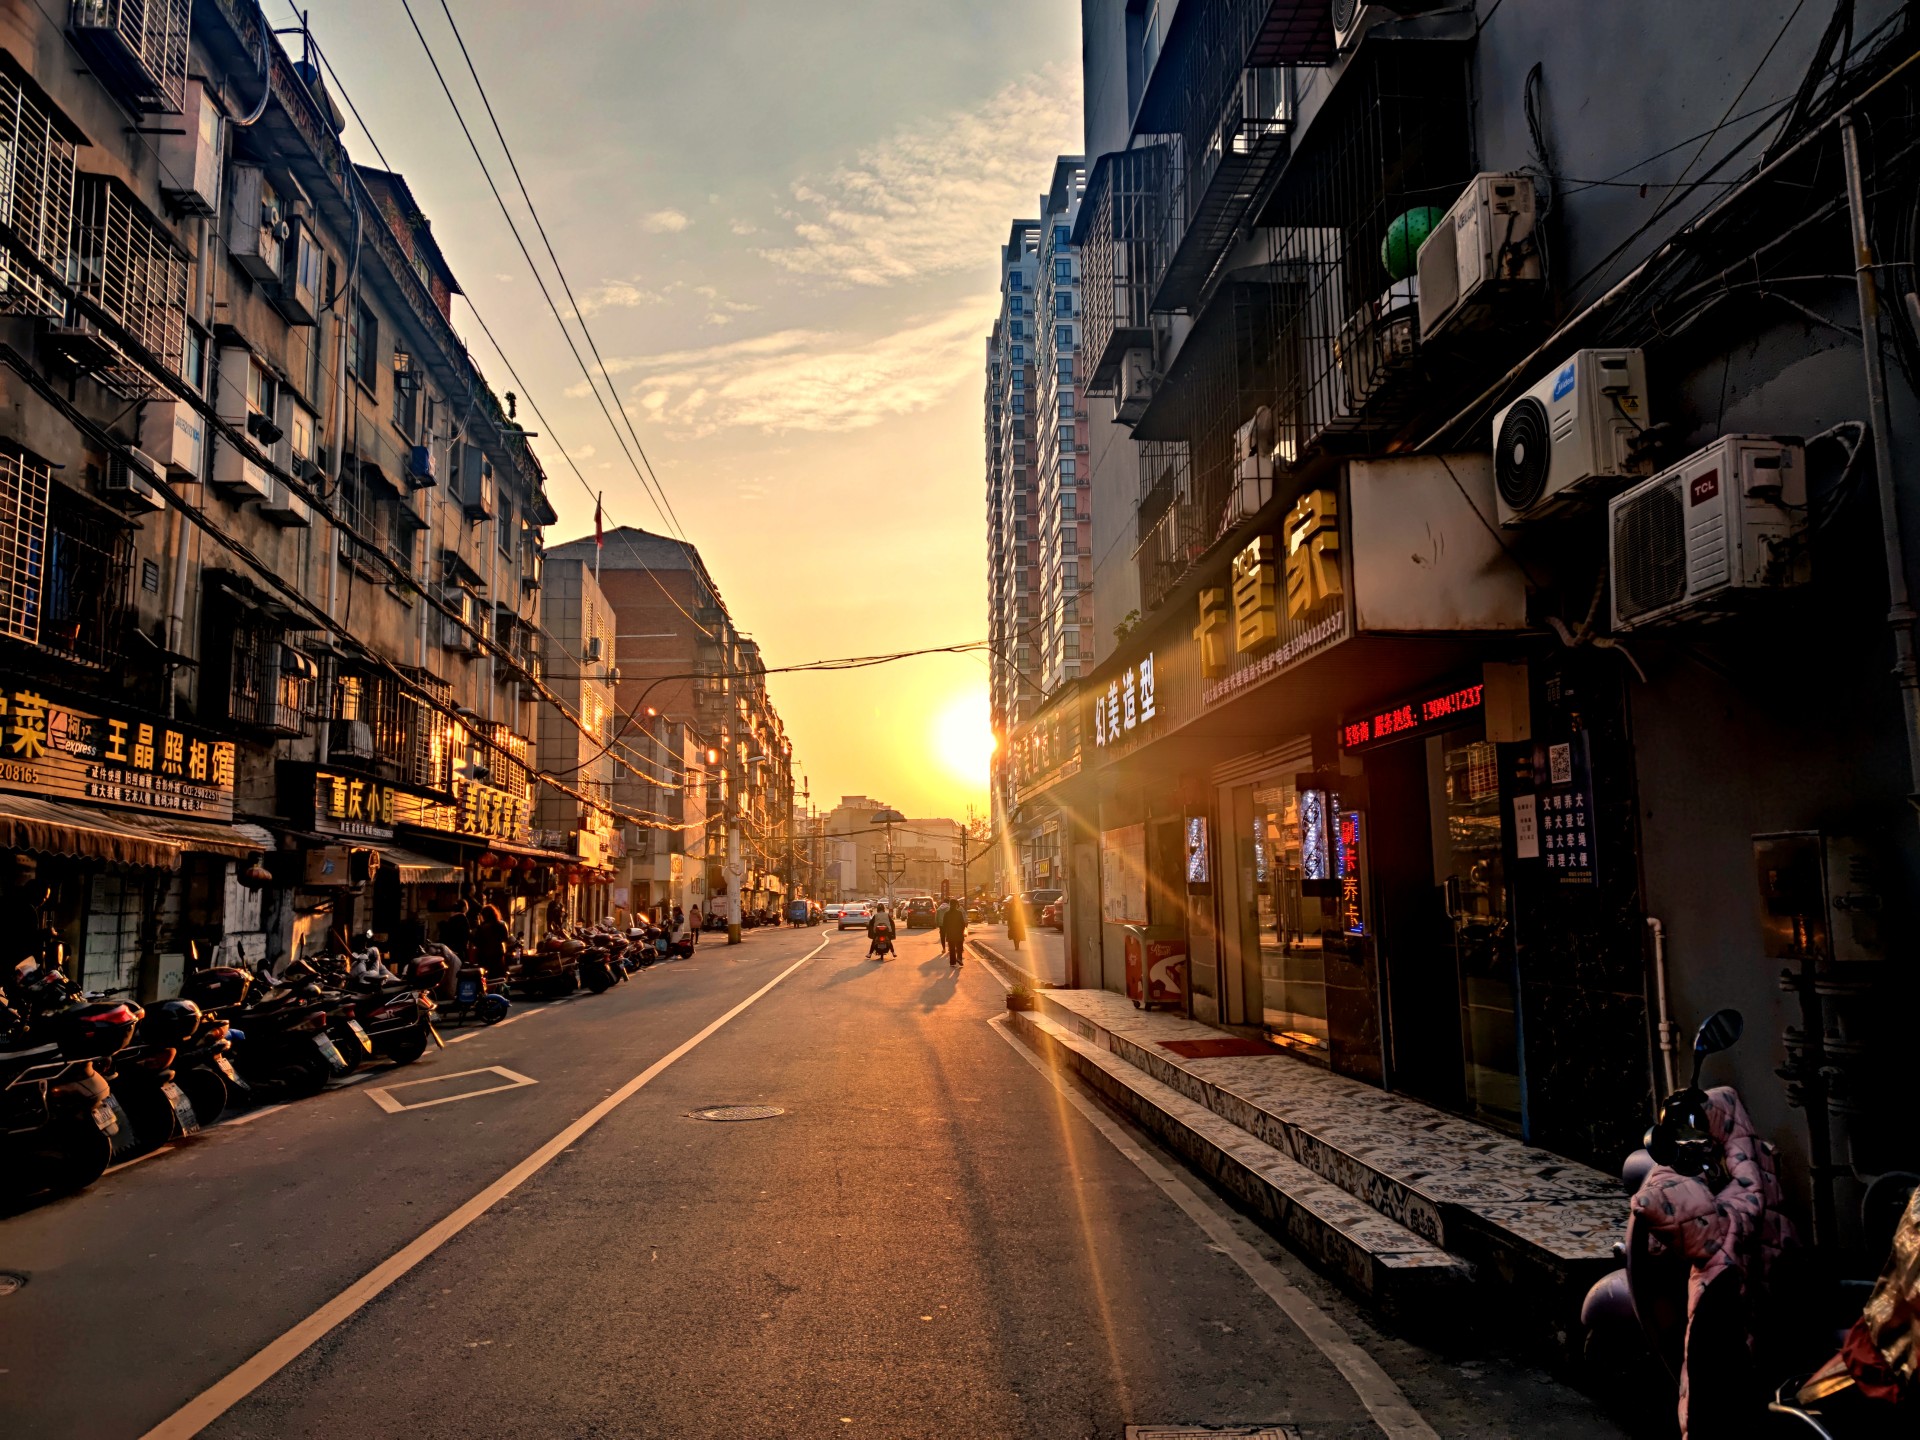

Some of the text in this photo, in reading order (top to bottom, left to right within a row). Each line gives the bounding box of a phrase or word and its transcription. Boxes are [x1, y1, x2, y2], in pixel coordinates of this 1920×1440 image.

[1556, 376, 1574, 394] Midea
[1694, 480, 1715, 496] TCL
[1095, 651, 1156, 748] 幻美造型
[1422, 684, 1484, 721] 1309411233
[0, 688, 49, 758] 菜
[65, 740, 97, 757] express
[105, 718, 230, 787] 王晶照相馆
[330, 776, 395, 825] 重庆小厨
[462, 780, 525, 841] 美味家常菜
[1543, 792, 1584, 811] 文明养犬
[1544, 812, 1586, 830] 养犬登记
[1341, 821, 1360, 927] 刷卡养卡
[1546, 852, 1589, 868] 清理犬便
